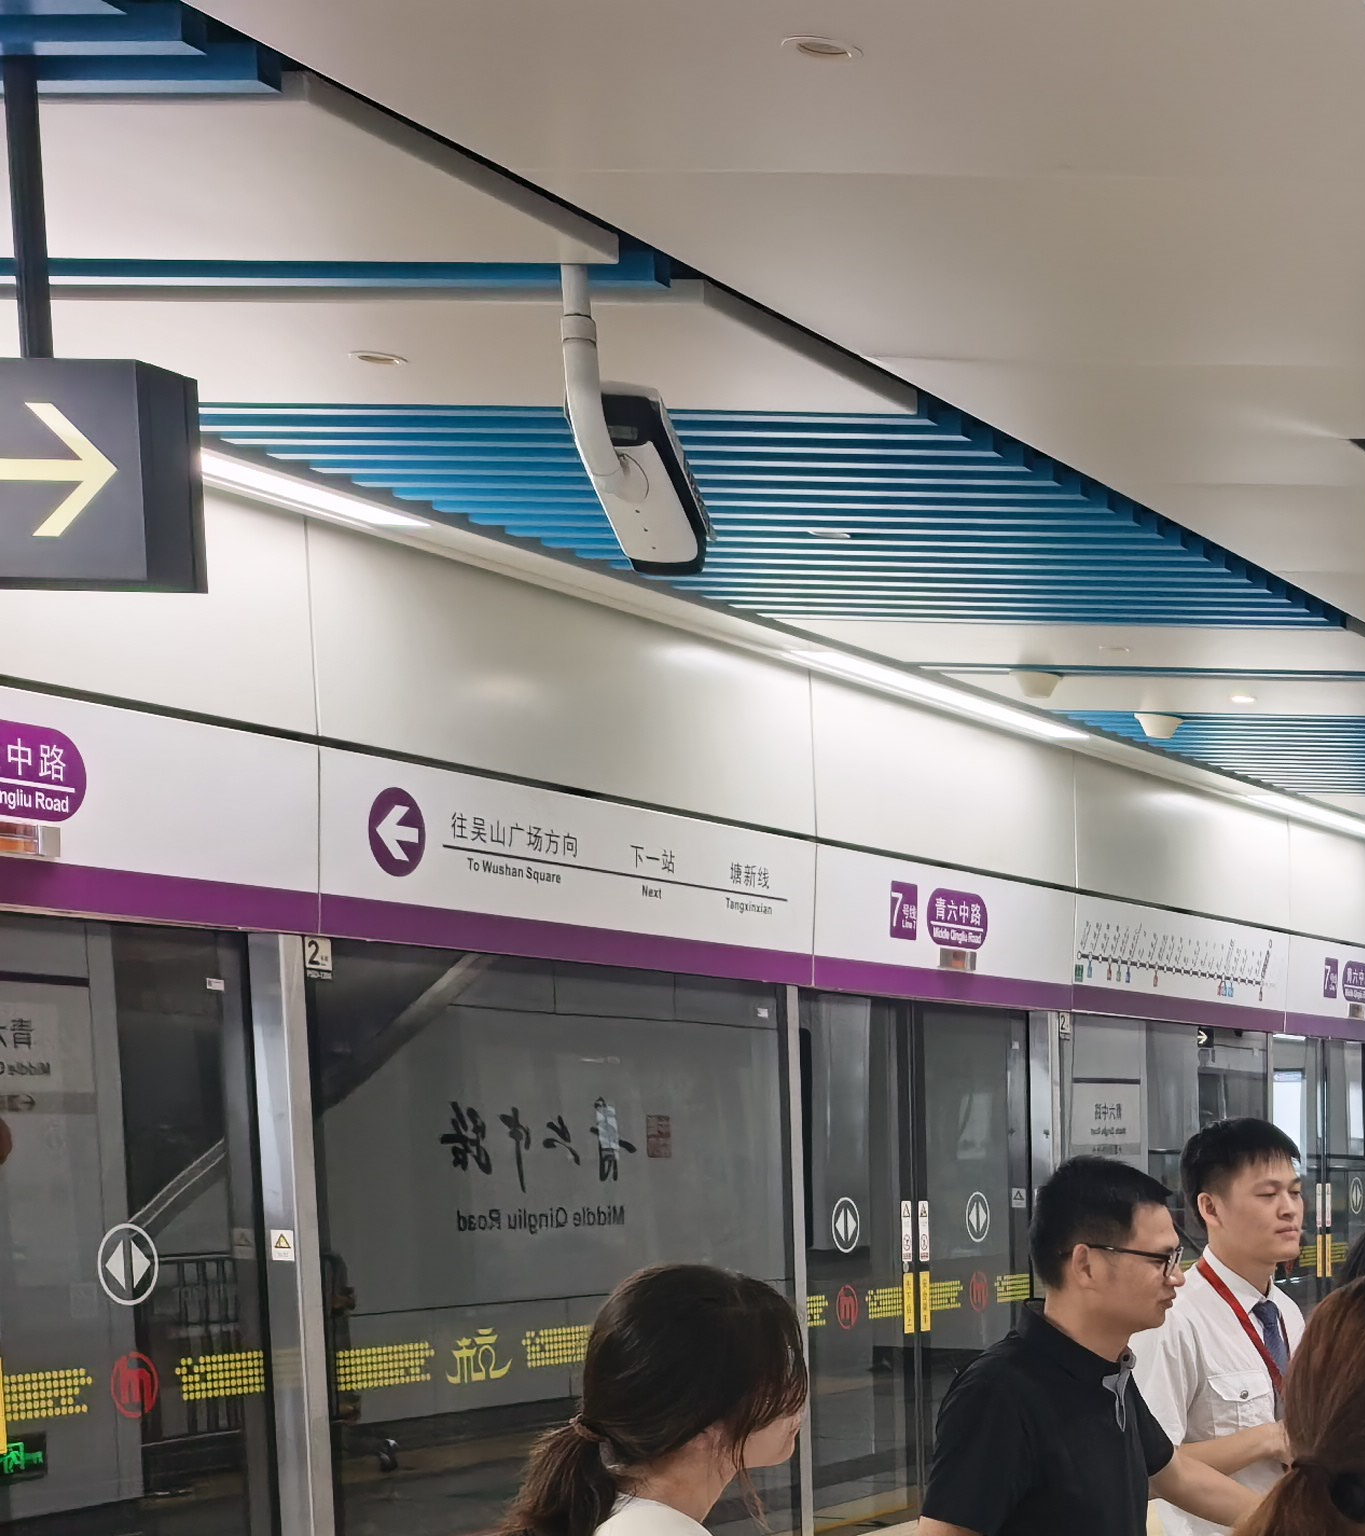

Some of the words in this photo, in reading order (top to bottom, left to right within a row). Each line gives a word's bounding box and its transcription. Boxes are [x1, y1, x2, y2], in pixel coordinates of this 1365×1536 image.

[35, 792, 69, 813] Road
[451, 812, 578, 858] 往吴山广场方向
[467, 857, 480, 872] To
[482, 860, 524, 879] Wushan
[526, 867, 561, 884] Square
[630, 845, 675, 874] 下一站
[730, 861, 770, 890] 塘新线
[642, 885, 662, 900] Next
[725, 897, 773, 915] Tangxinxian
[935, 897, 981, 926] 青六中路
[308, 940, 320, 966] 2
[1060, 1015, 1066, 1030] 2
